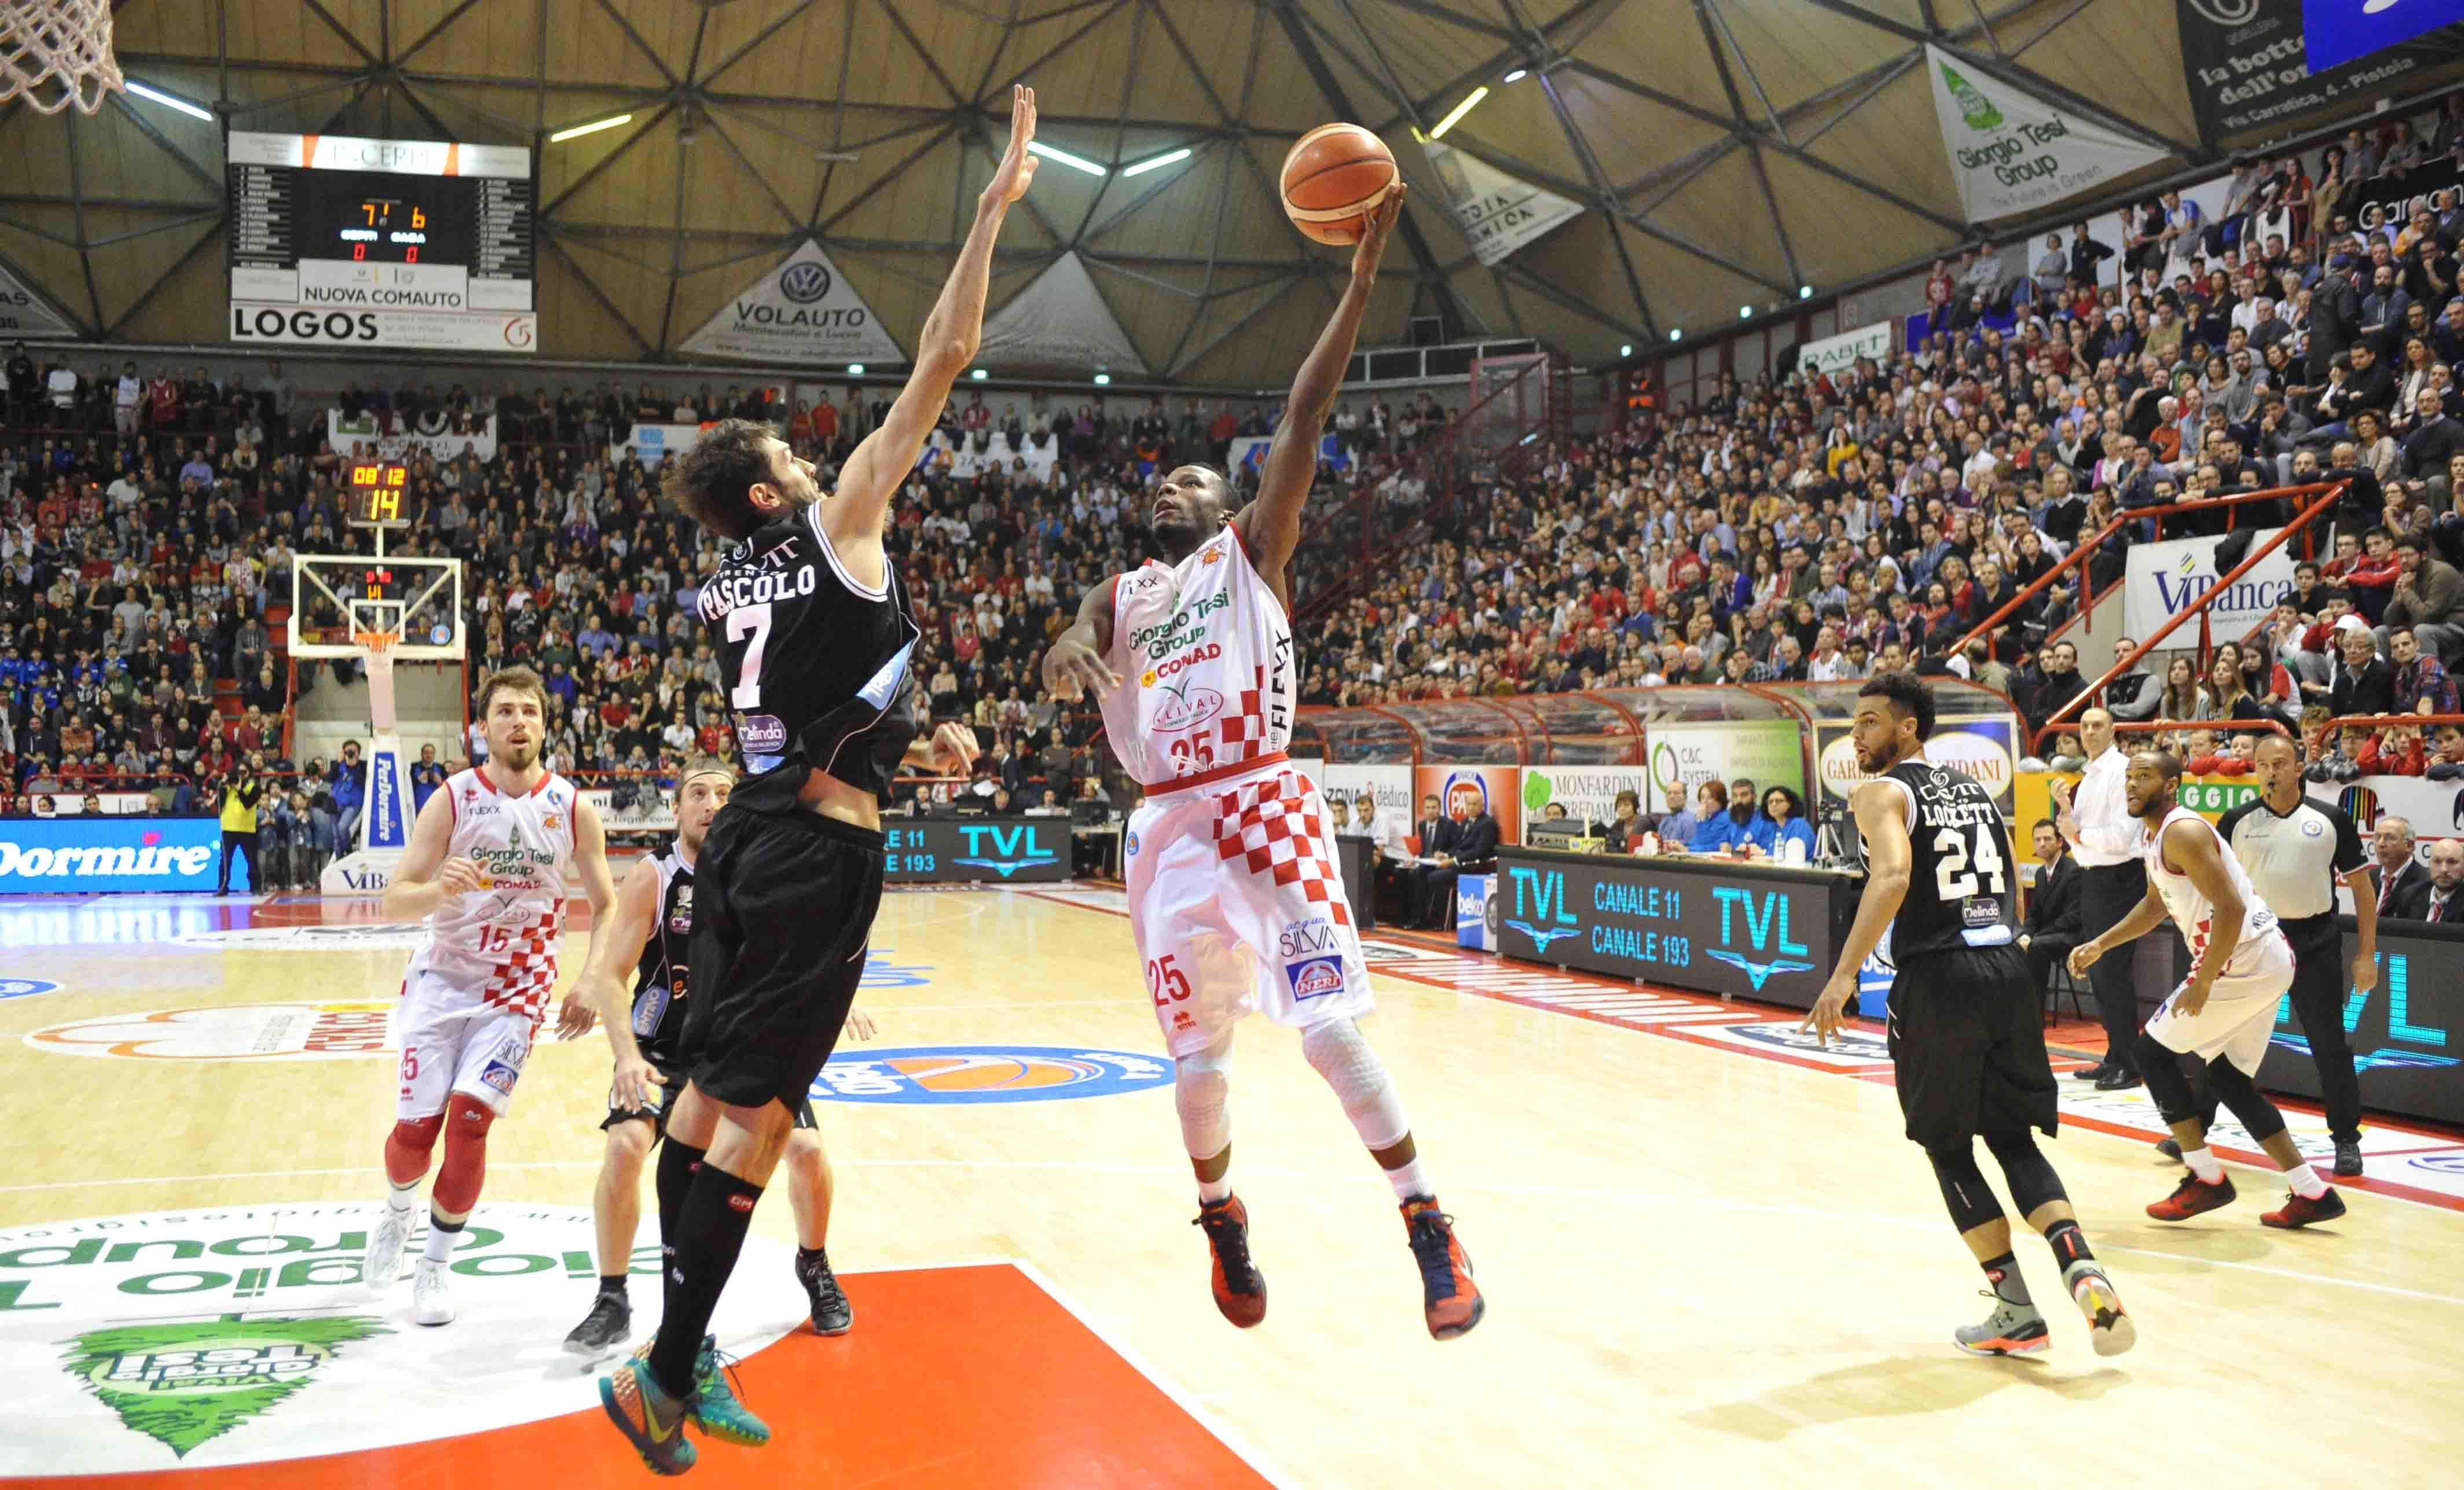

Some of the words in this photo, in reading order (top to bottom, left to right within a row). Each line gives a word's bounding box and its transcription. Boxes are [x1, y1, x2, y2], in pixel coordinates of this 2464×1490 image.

[2199, 67, 2230, 86] la
[2326, 84, 2338, 97] 4
[2349, 57, 2415, 88] Pistoia
[1957, 137, 2023, 170] Giorgio
[2017, 113, 2070, 145] Tesi
[1994, 155, 2058, 186] Group
[2061, 164, 2102, 188] Green
[354, 243, 365, 260] 0
[406, 245, 419, 263] 0
[305, 287, 366, 303] NUOVA
[372, 289, 461, 307] COMAUTO
[234, 309, 379, 340] LOGOS
[736, 300, 865, 327] VOLAUTO
[387, 468, 405, 486] 12
[371, 489, 400, 520] 14
[704, 565, 816, 621] PASCOLO
[1129, 611, 1190, 651] Giorgio
[1148, 625, 1206, 660] Group
[726, 603, 772, 710] 7
[1157, 643, 1222, 678] CONAD
[1170, 730, 1215, 776] 25
[1681, 747, 1703, 765] C&C
[1556, 775, 1642, 797] MONFARDINI
[2178, 786, 2257, 809] GGIO
[1922, 803, 1995, 828] LOCKETT
[906, 830, 925, 847] 11
[958, 825, 1054, 856] TVL
[471, 846, 525, 864] Giorgio
[527, 848, 556, 867] Tesi
[490, 862, 534, 878] Group
[904, 854, 936, 872] 193
[1934, 823, 2006, 901] 24
[493, 879, 542, 890] CONAD
[1509, 867, 1578, 924] TVL
[1458, 888, 1484, 918] beko
[1593, 881, 1660, 918] CANALE
[1663, 889, 1681, 920] 11
[1963, 903, 1999, 919] Melinda
[1711, 886, 1808, 957] TVL
[479, 924, 512, 953] 15
[1278, 926, 1342, 958] SILVA
[1592, 925, 1658, 963] CANALE
[1662, 936, 1690, 968] 193
[1148, 954, 1191, 1007] 25
[1298, 974, 1340, 994] NERI
